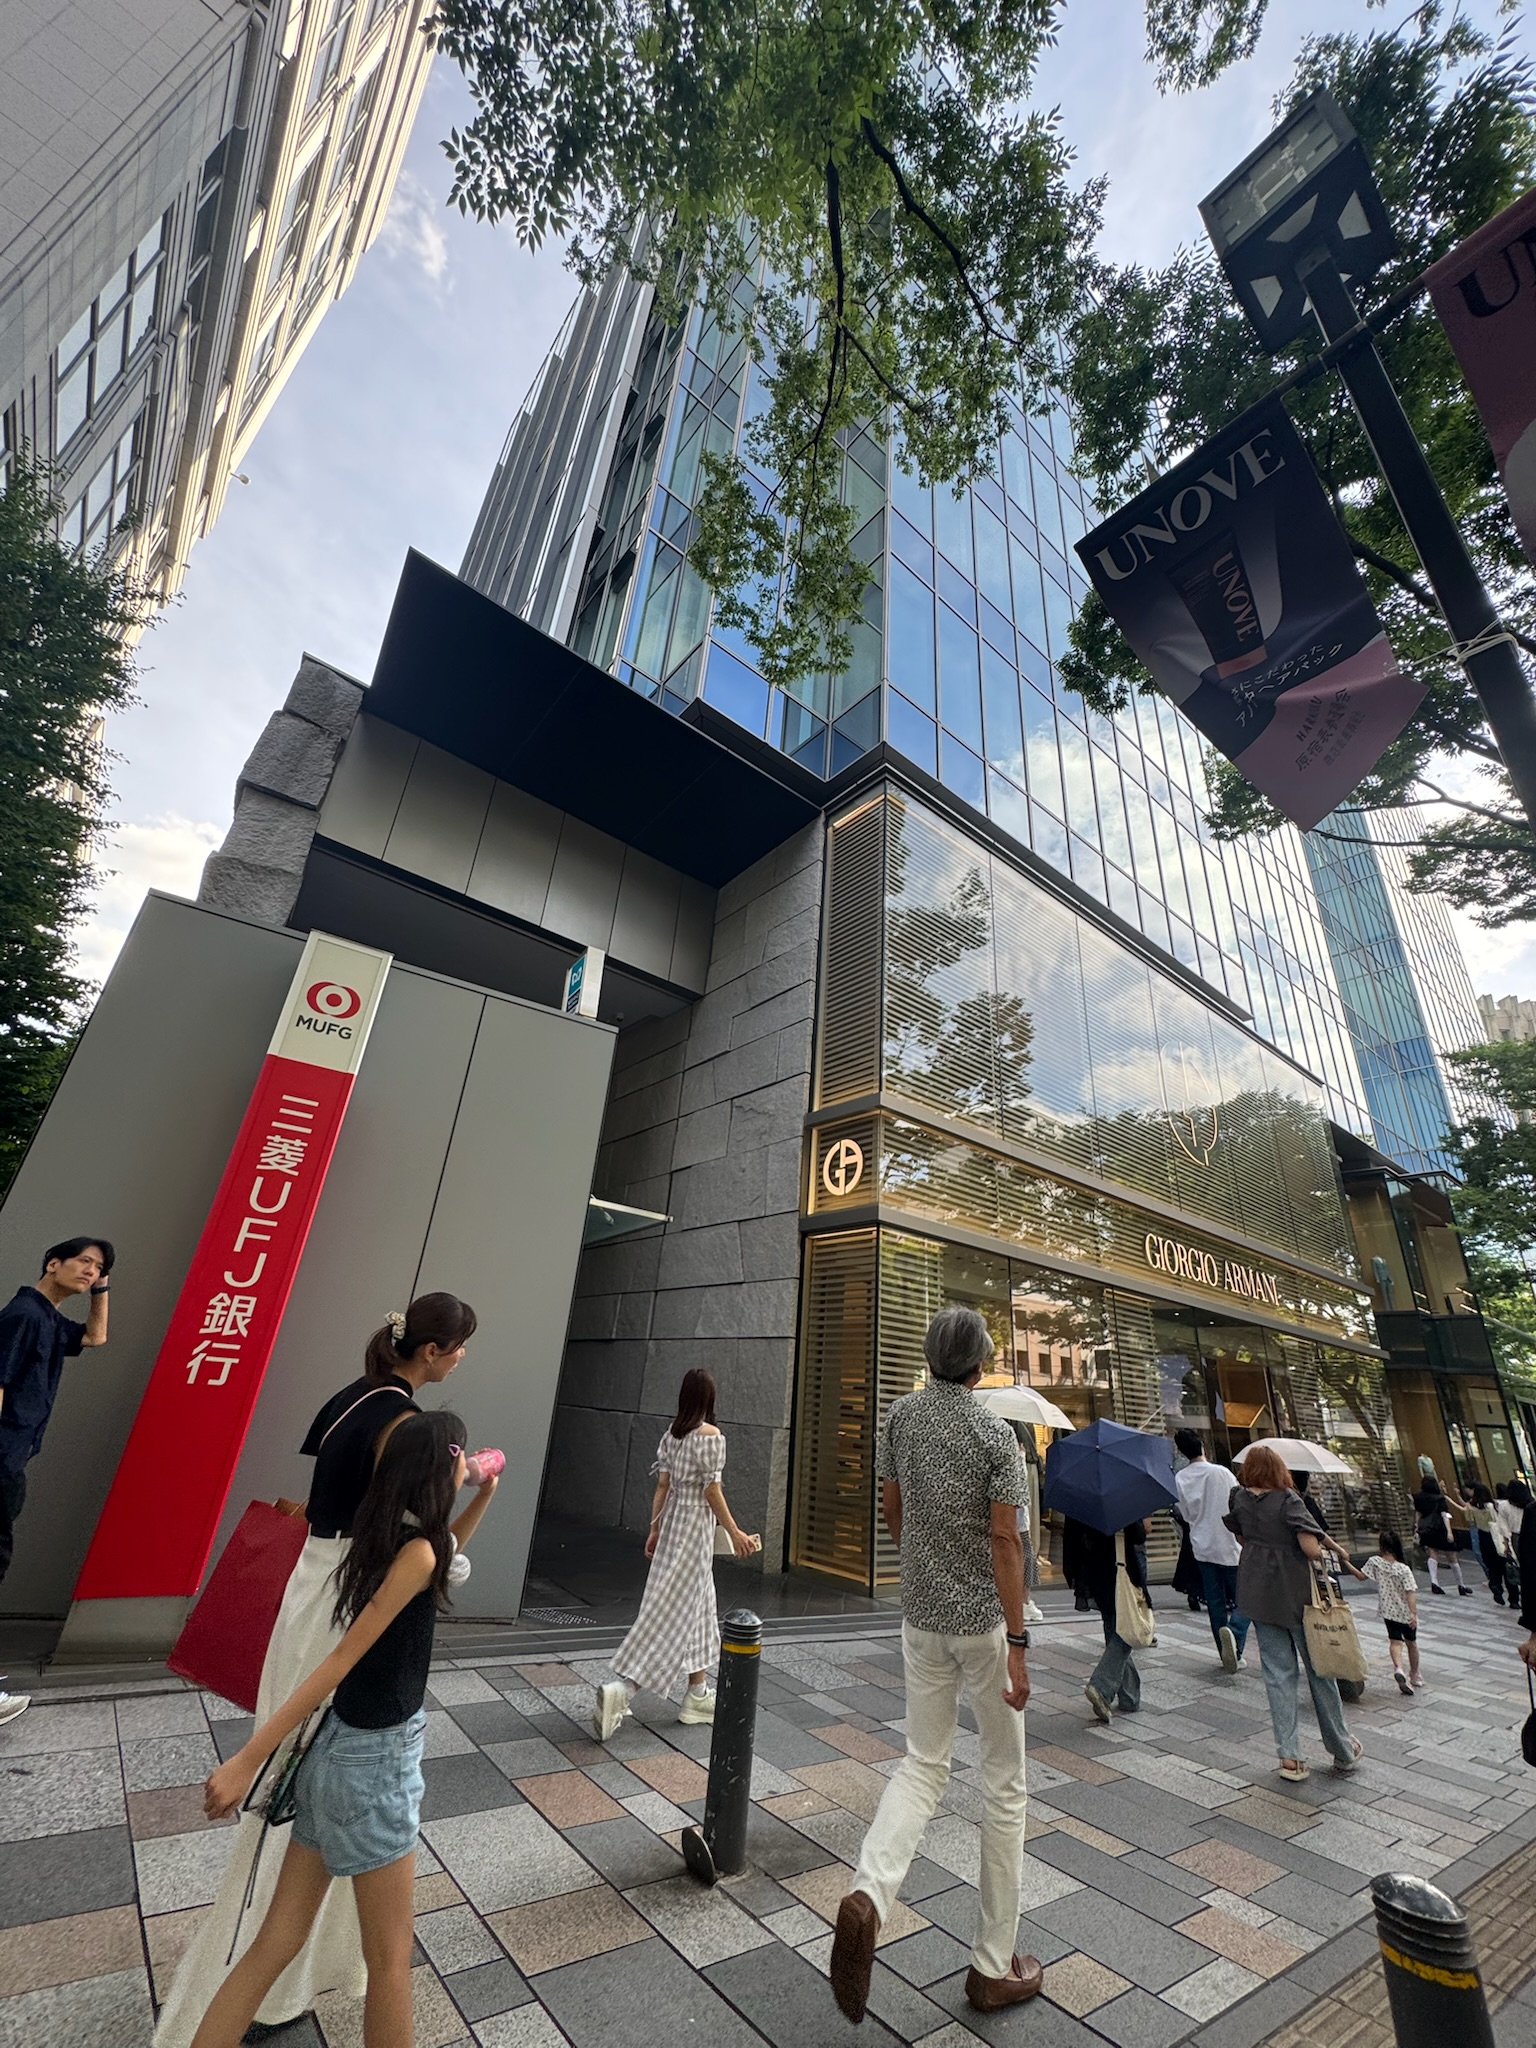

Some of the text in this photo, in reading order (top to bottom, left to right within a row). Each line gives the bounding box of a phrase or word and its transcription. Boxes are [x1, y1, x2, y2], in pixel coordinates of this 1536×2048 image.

[1094, 428, 1286, 581] UNOVE
[1211, 550, 1260, 643] UNOVE
[295, 1014, 353, 1041] MUFG
[186, 1094, 319, 1387] 三菱UFJ銀行
[1145, 1232, 1281, 1306] GIORGIO ARMANI
